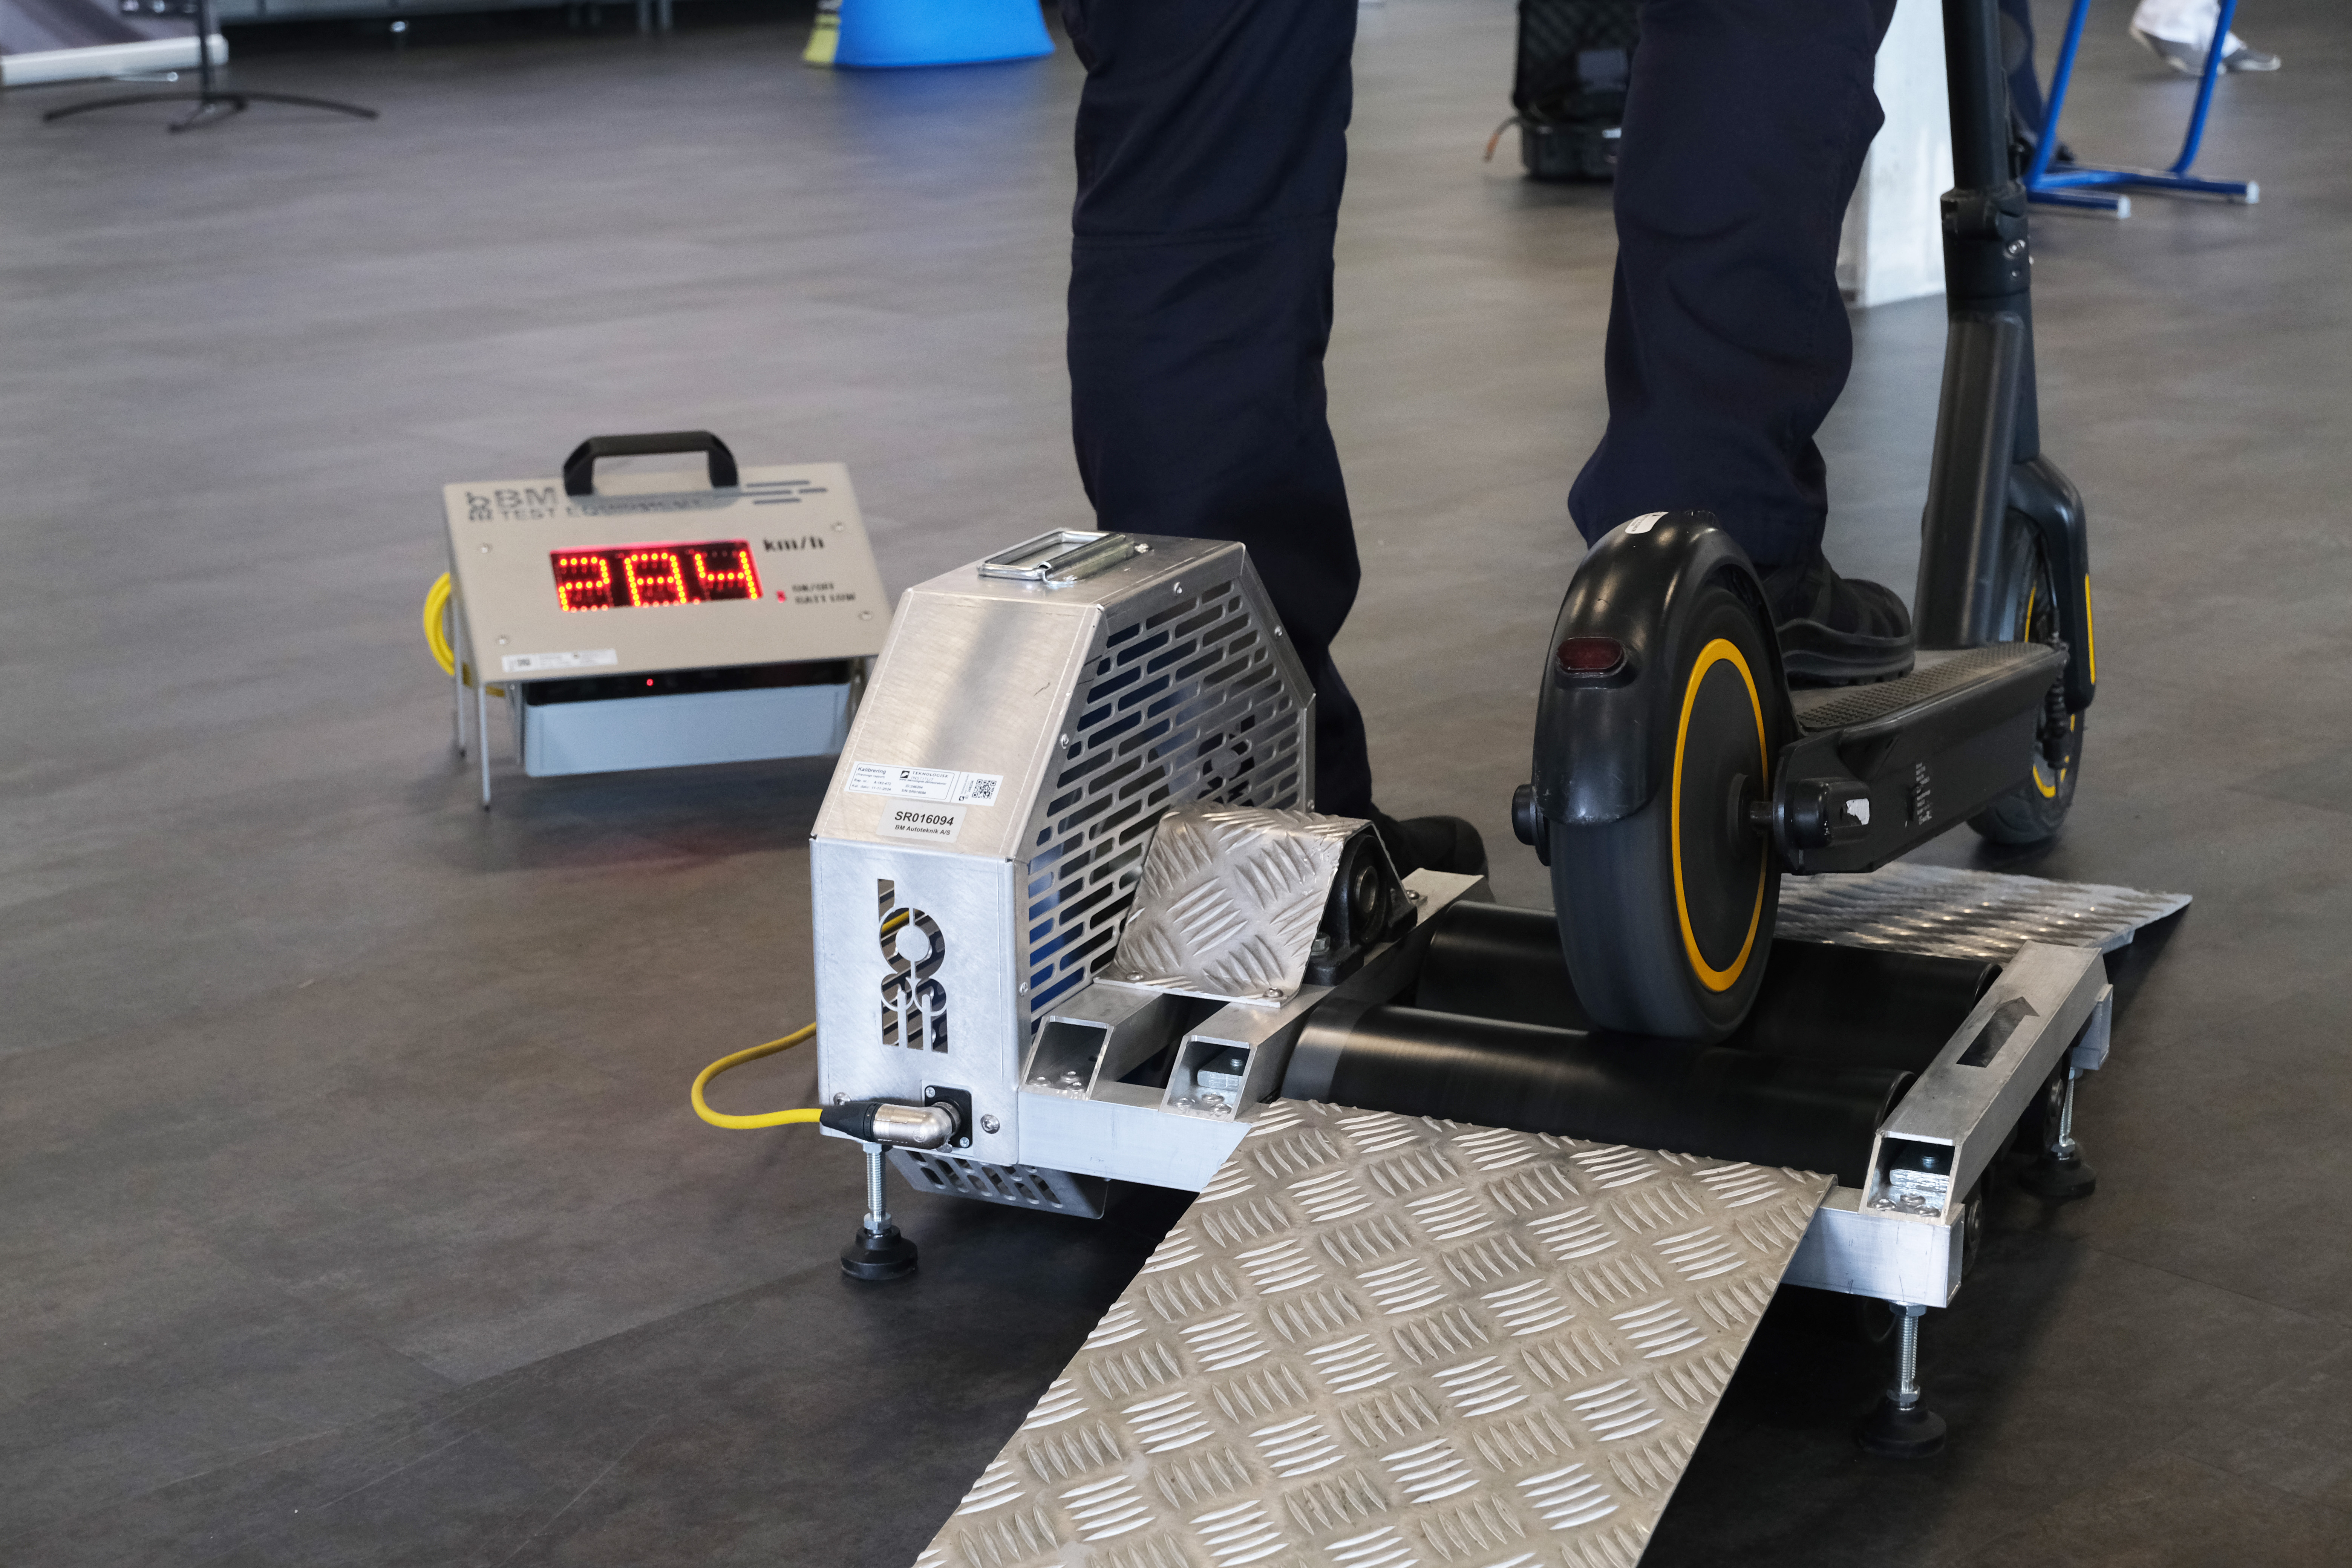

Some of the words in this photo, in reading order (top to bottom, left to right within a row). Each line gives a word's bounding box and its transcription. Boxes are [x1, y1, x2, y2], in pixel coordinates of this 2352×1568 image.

[494, 487, 559, 508] BM
[763, 536, 825, 552] km/h
[894, 811, 954, 826] SR016094
